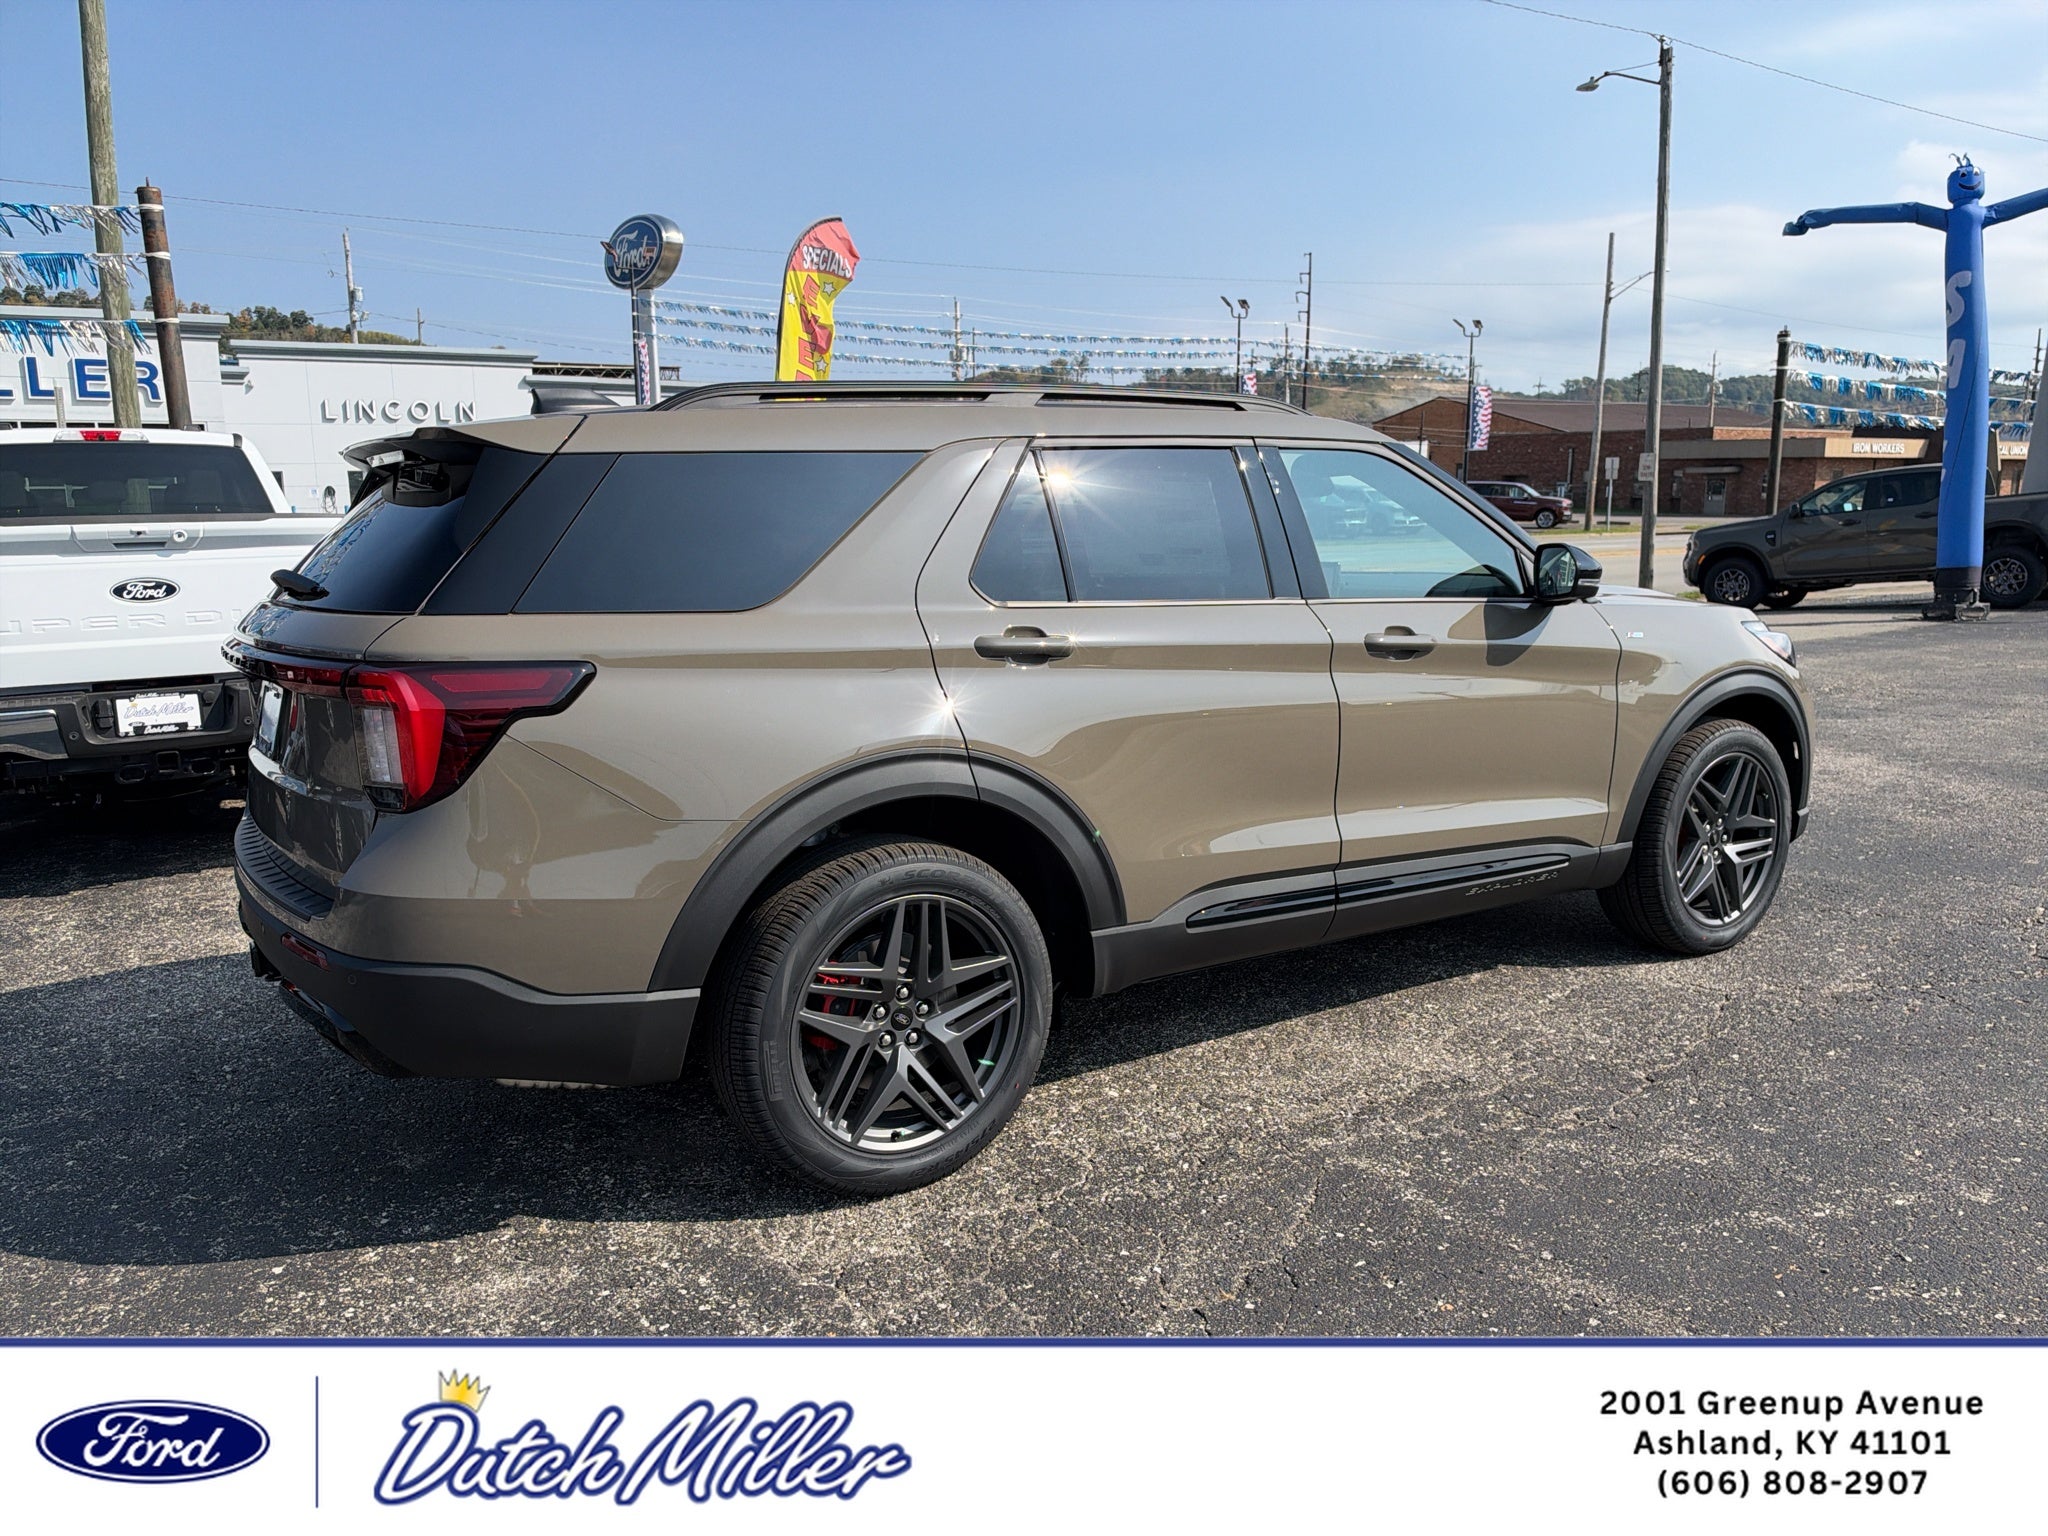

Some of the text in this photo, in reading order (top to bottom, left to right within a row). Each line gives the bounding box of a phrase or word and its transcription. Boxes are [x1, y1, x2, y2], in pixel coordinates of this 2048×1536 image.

[613, 230, 649, 277] Ford
[802, 244, 852, 278] SPECIALS
[321, 400, 476, 423] LINCOLN
[1852, 442, 1905, 455] IRON WORKERS
[123, 581, 167, 599] Ford
[124, 702, 194, 719] Dutch Miller
